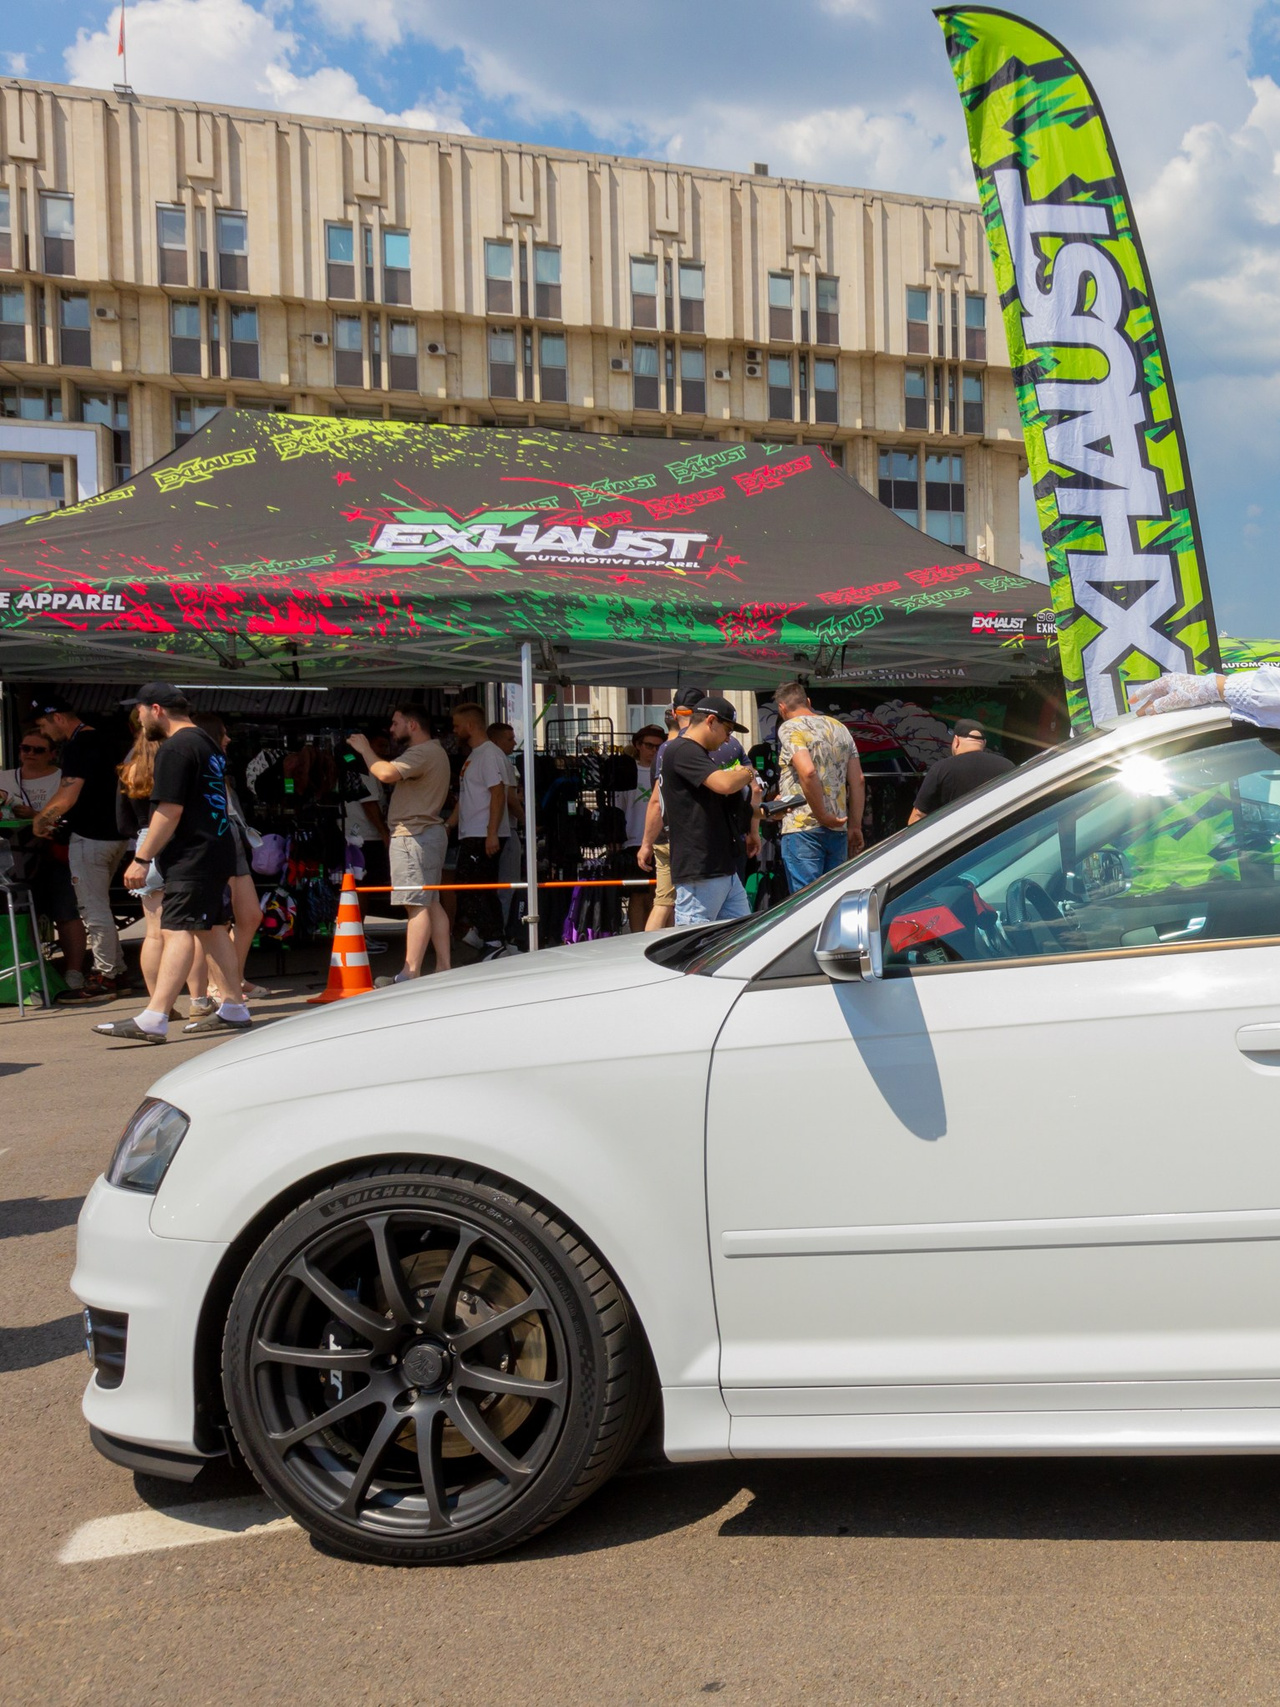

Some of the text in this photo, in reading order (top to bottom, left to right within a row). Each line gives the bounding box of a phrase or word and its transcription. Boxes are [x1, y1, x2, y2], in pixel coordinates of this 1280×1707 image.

[151, 448, 257, 492] EXHAUST
[664, 445, 746, 484] EXHAUST
[732, 455, 812, 497] EXHAUST
[569, 474, 657, 507] EXHAUST
[360, 511, 708, 565] EXHAUST
[525, 555, 700, 569] AUTOMOTIVE APPAREL
[16, 592, 125, 611] APPAREL
[970, 612, 1027, 634] EXHAUST
[346, 1185, 440, 1206] MICHELIN
